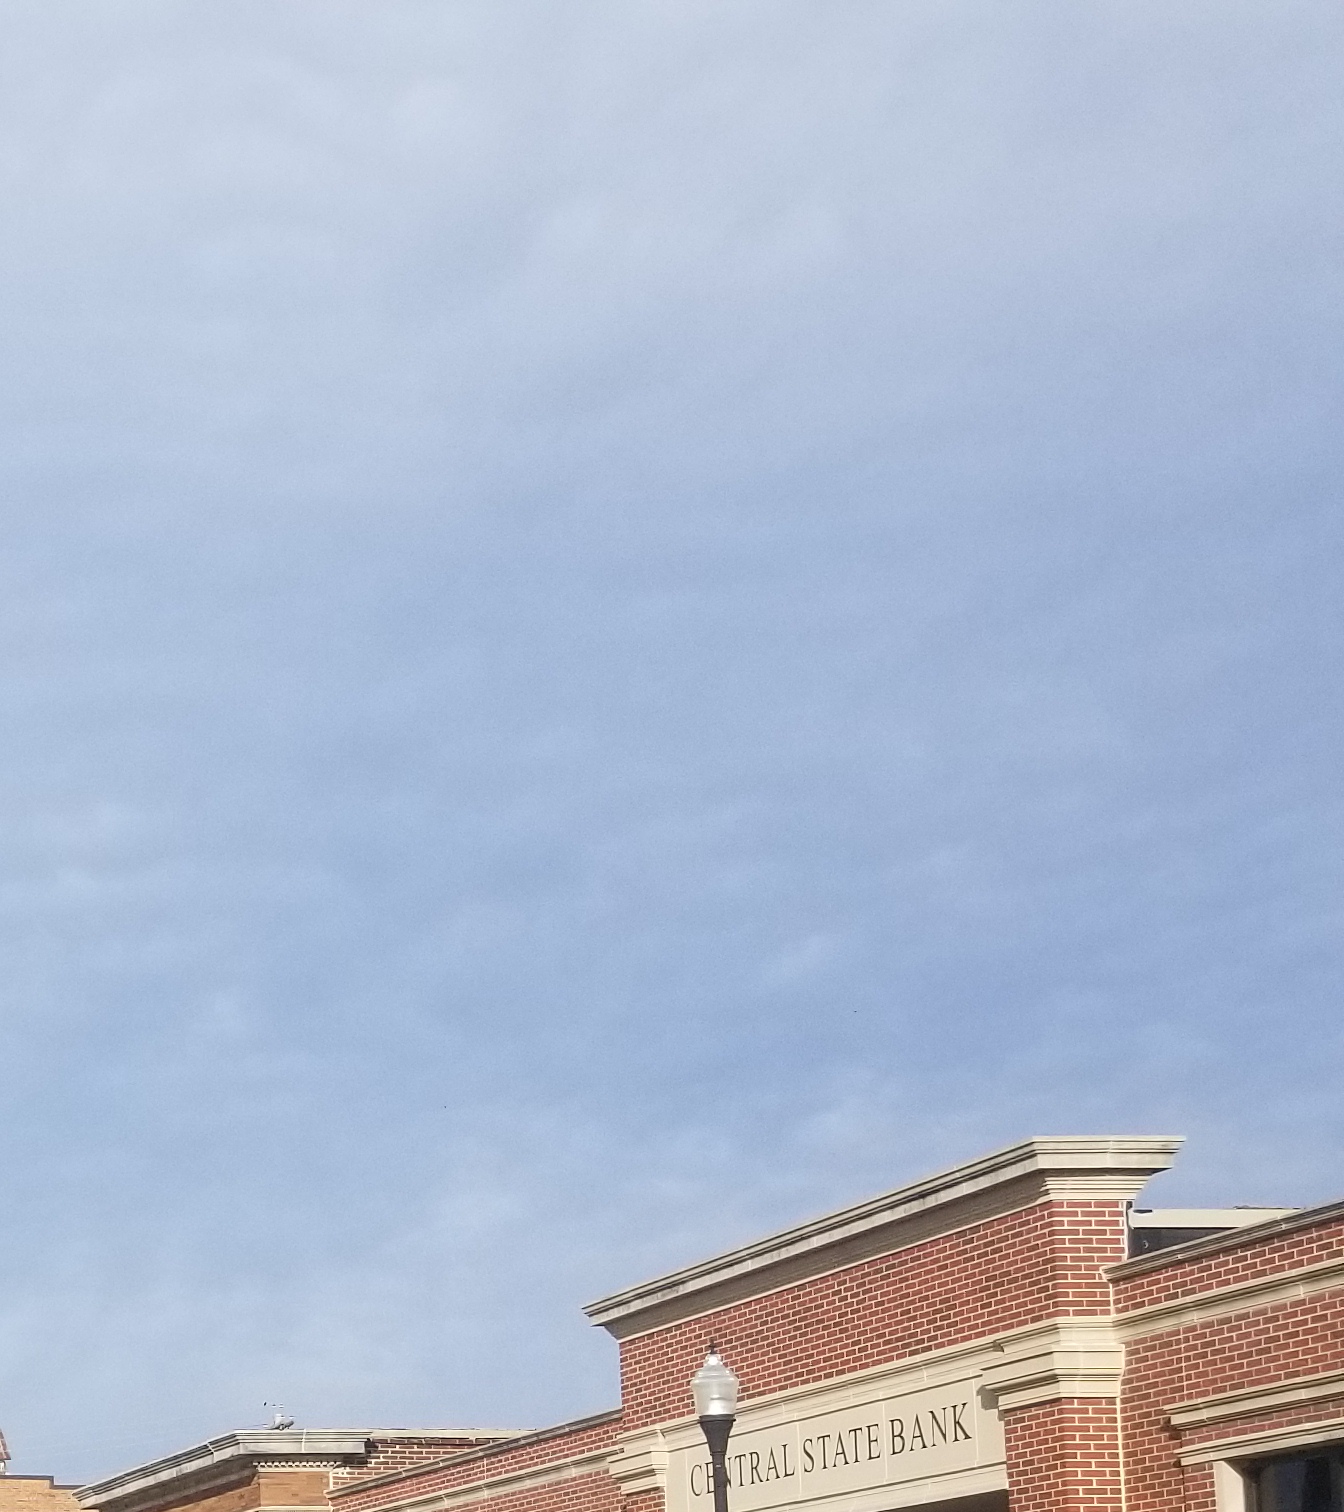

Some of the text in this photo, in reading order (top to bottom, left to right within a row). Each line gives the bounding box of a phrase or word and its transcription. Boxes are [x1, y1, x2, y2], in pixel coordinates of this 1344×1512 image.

[690, 1402, 973, 1497] CENTRAL STATE BANK
